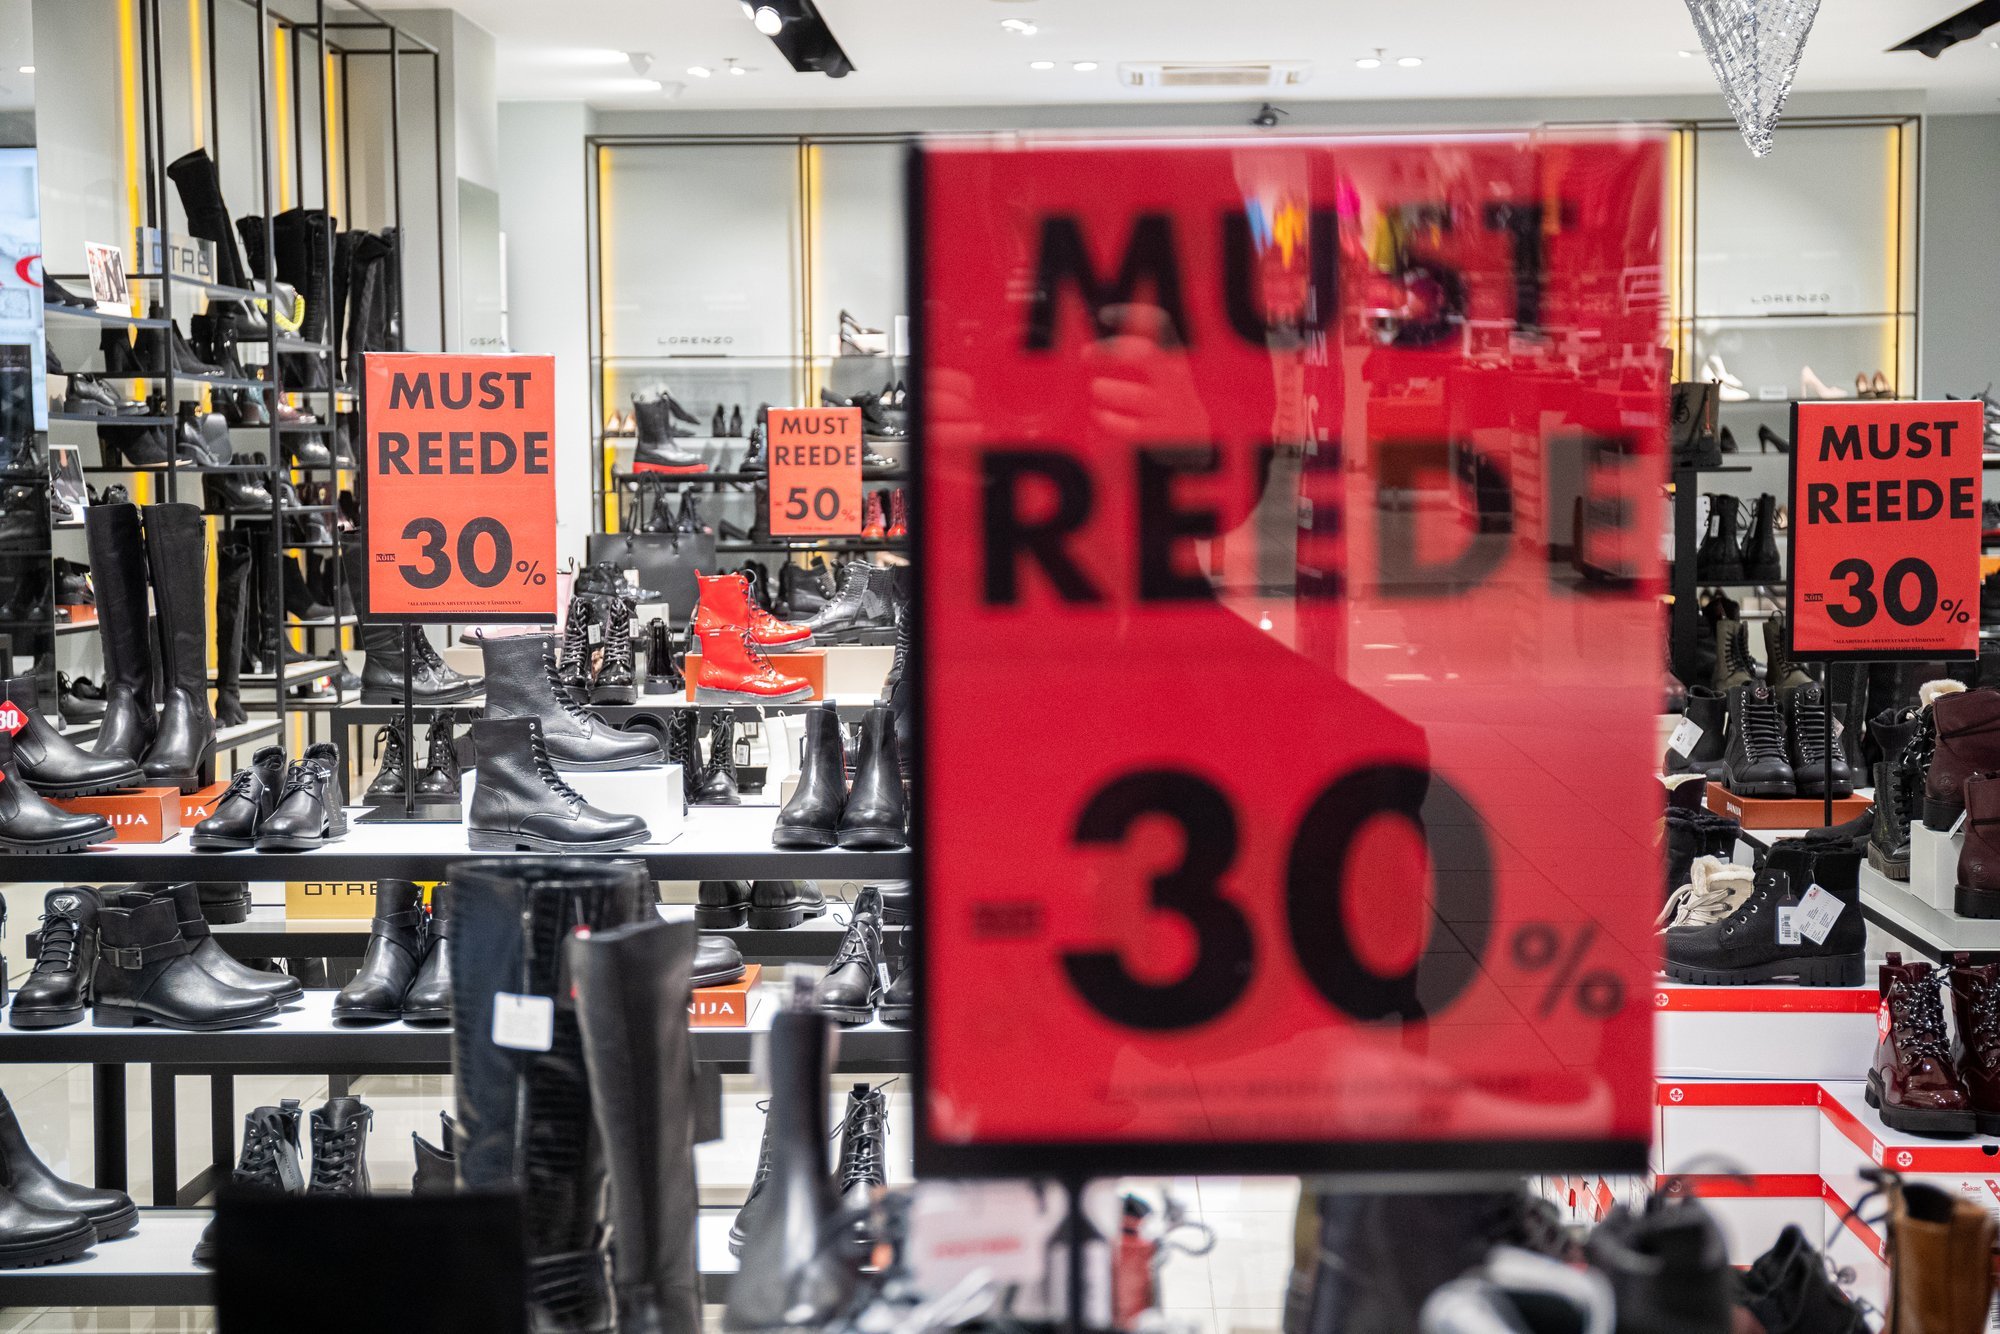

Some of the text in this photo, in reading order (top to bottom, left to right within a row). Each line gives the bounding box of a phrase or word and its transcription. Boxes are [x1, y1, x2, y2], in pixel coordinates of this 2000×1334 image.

[1024, 202, 1575, 352] MUST
[1750, 293, 1830, 304] LORENZO
[657, 336, 735, 345] LORENZO
[389, 372, 532, 410] MUST
[781, 417, 848, 435] MUST
[1819, 420, 1959, 462] MUST
[378, 431, 548, 475] REEDE
[775, 445, 856, 466] REEDE
[979, 430, 1642, 607] REEDE
[1808, 477, 1975, 525] REEDE
